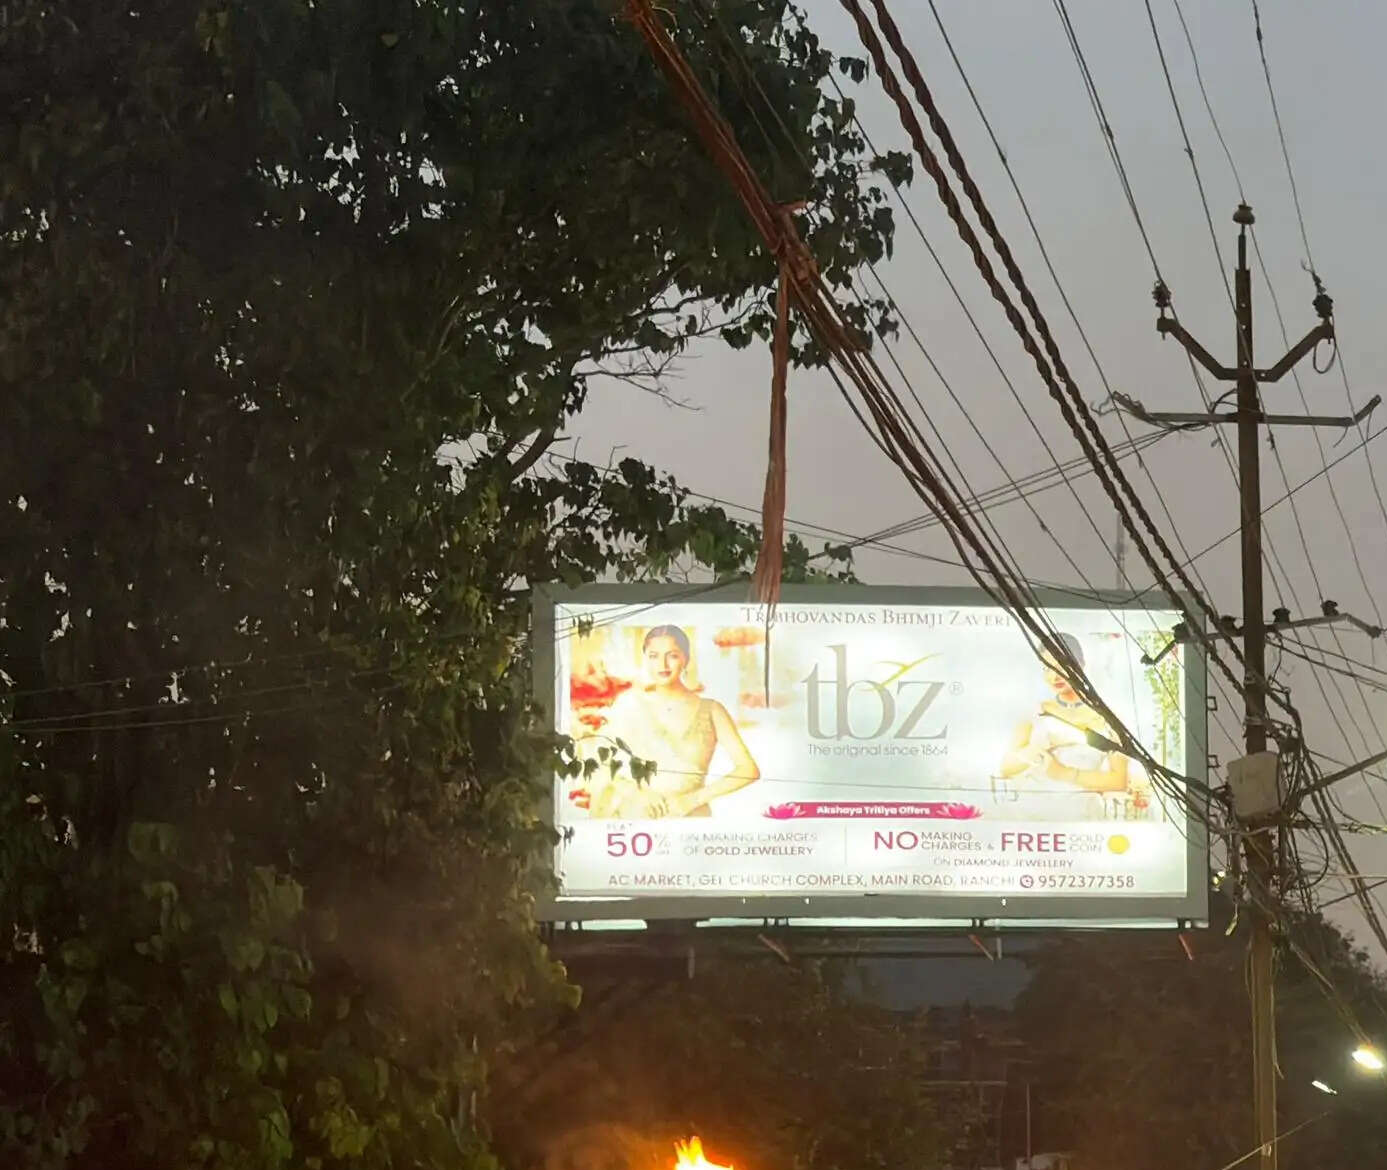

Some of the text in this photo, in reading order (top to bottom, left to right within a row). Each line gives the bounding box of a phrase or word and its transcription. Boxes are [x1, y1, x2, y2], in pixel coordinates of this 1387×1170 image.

[800, 644, 948, 741] tbz
[808, 744, 831, 756] The
[834, 744, 882, 758] original
[883, 744, 919, 756] since
[816, 804, 931, 816] Akshaya Tritiya Offers
[873, 831, 919, 850] NO
[921, 832, 973, 841] MAKING
[1001, 832, 1067, 853] FREE
[704, 846, 741, 856] GOLD
[745, 846, 814, 856] JEWELLERY
[921, 842, 982, 851] CHARGES
[1013, 859, 1074, 869] JEWELLERY
[608, 874, 631, 887] AC
[634, 874, 696, 888] MARKET,
[871, 874, 911, 886] MAIN
[1038, 874, 1136, 889] 9572377358
